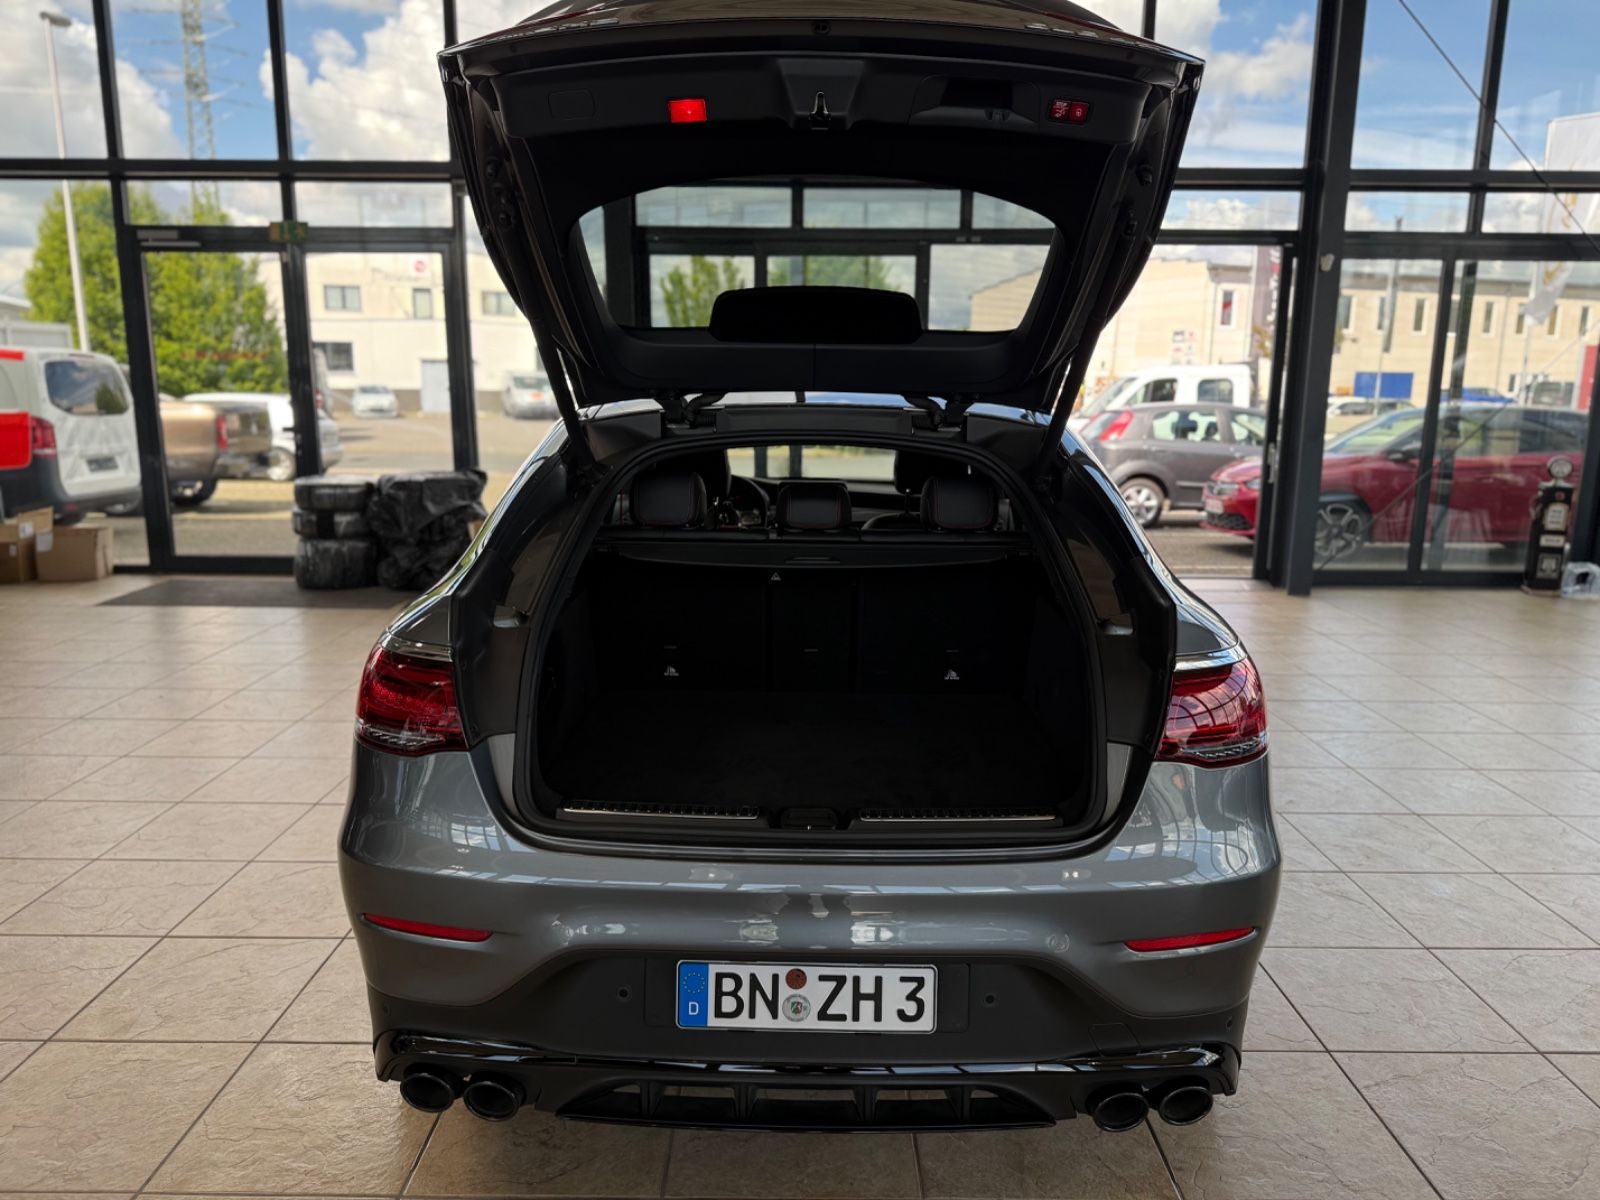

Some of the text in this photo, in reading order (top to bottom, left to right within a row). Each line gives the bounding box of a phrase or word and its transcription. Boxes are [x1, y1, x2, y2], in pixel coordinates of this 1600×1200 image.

[688, 1001, 699, 1016] D
[714, 972, 925, 1022] BN ZH 3
